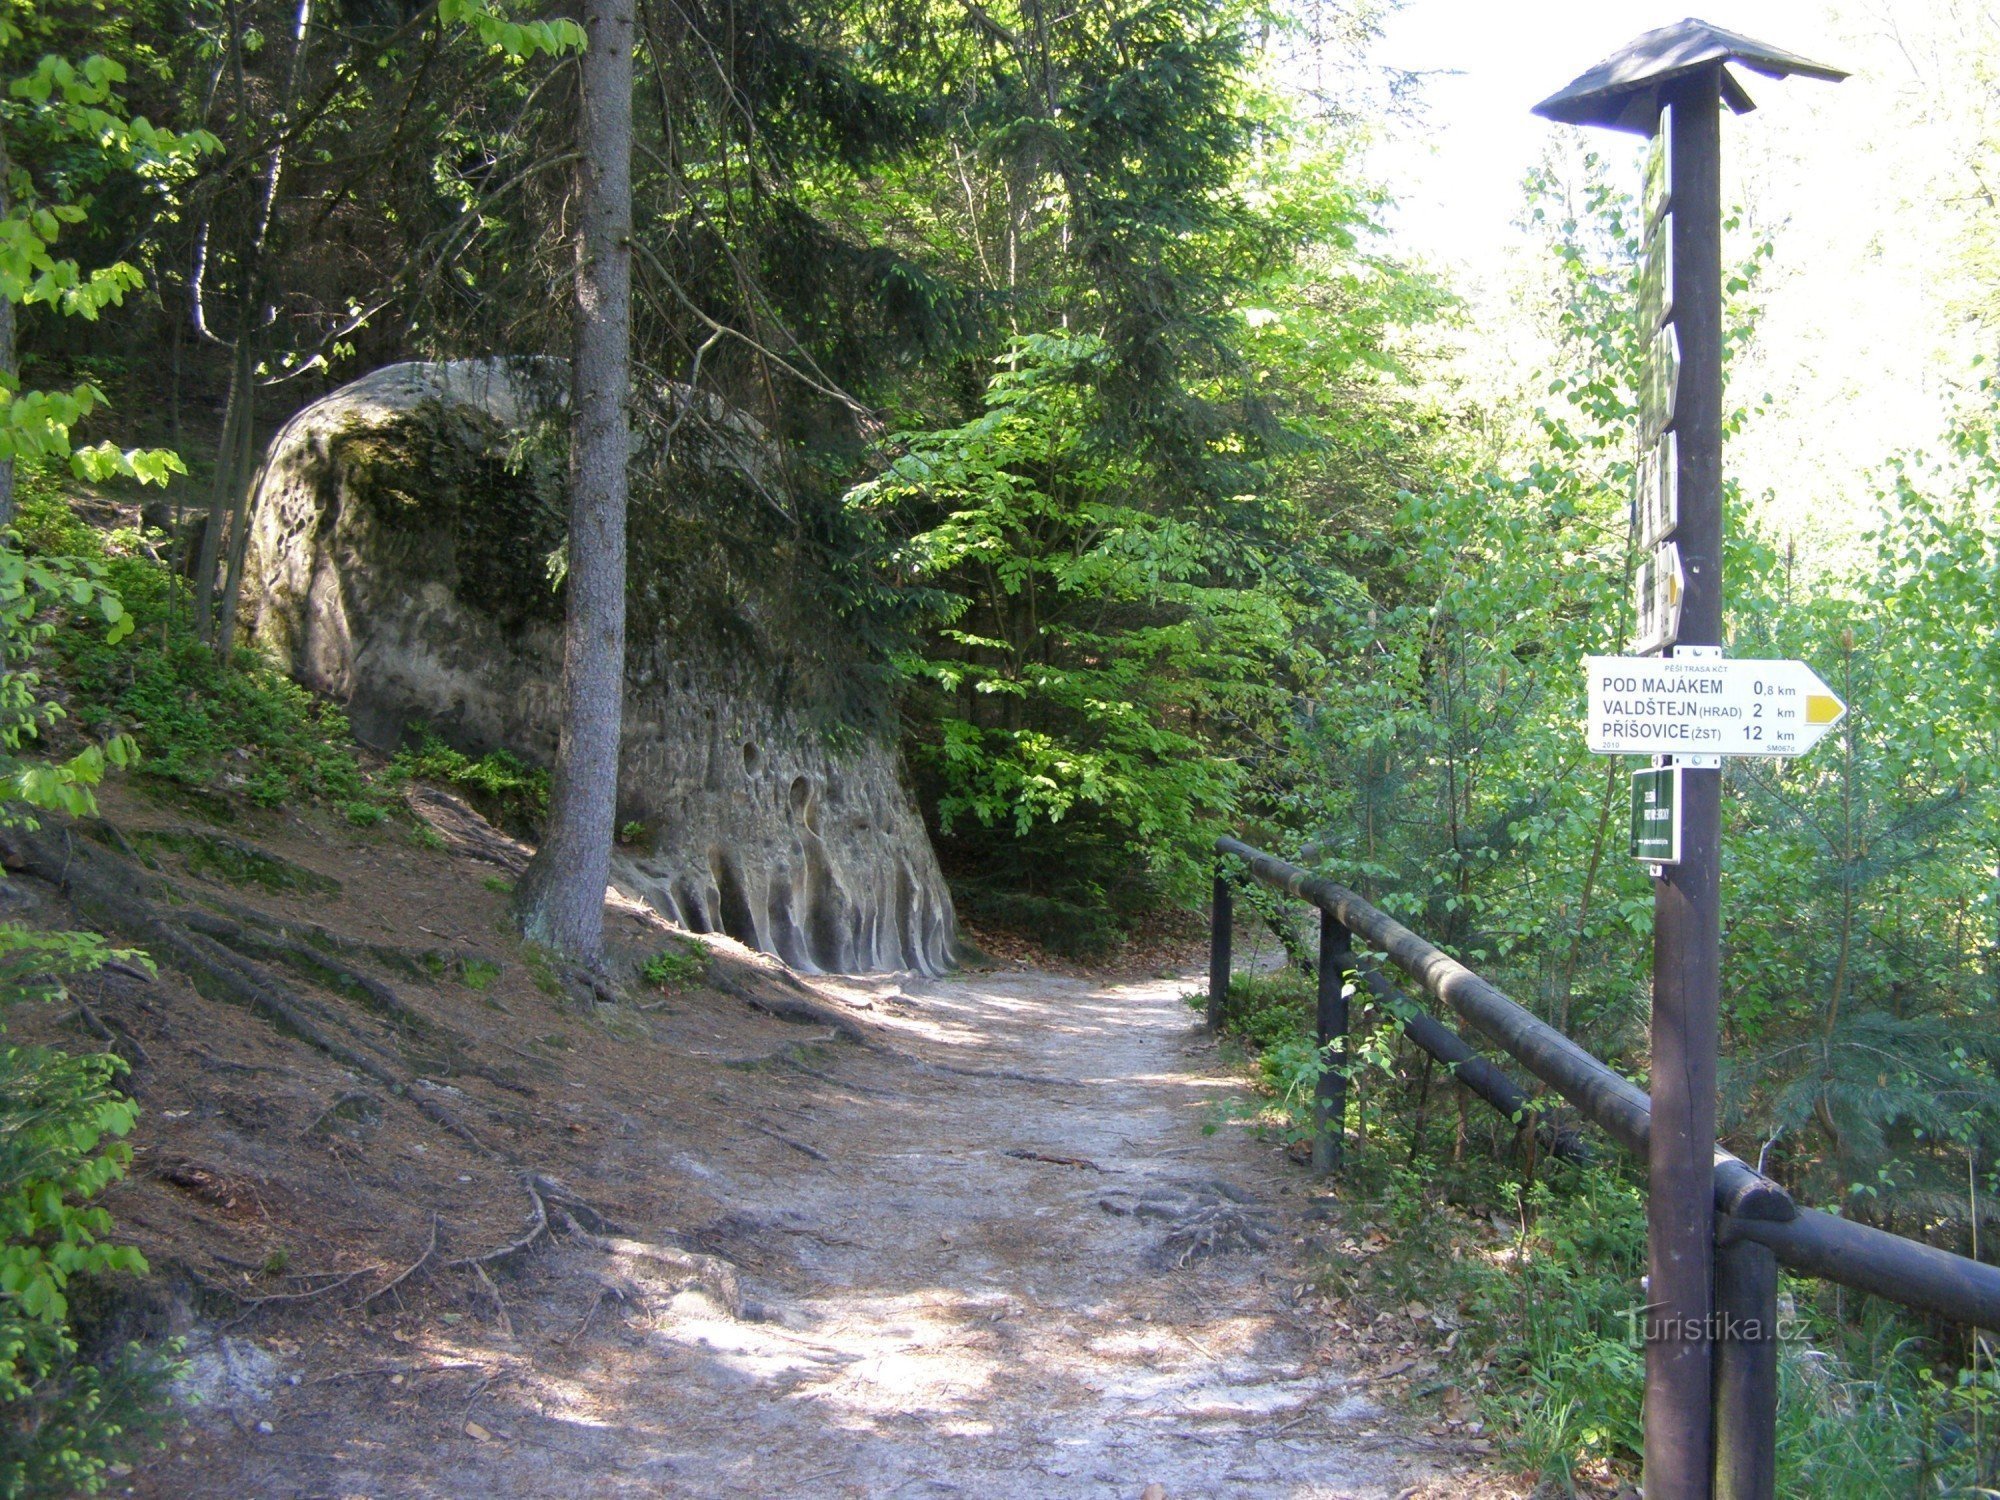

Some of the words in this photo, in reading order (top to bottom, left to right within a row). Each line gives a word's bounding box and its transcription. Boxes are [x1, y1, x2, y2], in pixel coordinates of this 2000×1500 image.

[1684, 665, 1711, 673] TRASA
[1712, 664, 1728, 673] KČT
[1602, 677, 1637, 692] POD
[1642, 675, 1723, 694] MAJÁKEM
[1753, 680, 1774, 695] 0,8
[1777, 686, 1796, 696] km
[1603, 697, 1697, 716] VALDŠTEJN
[1699, 706, 1742, 719] (HRAD)
[1753, 703, 1763, 718] 2
[1777, 707, 1795, 718] km
[1602, 719, 1689, 739] PŘÍŠOVICE
[1742, 725, 1763, 740] 12
[1776, 730, 1795, 741] km
[1602, 741, 1620, 749] 2010
